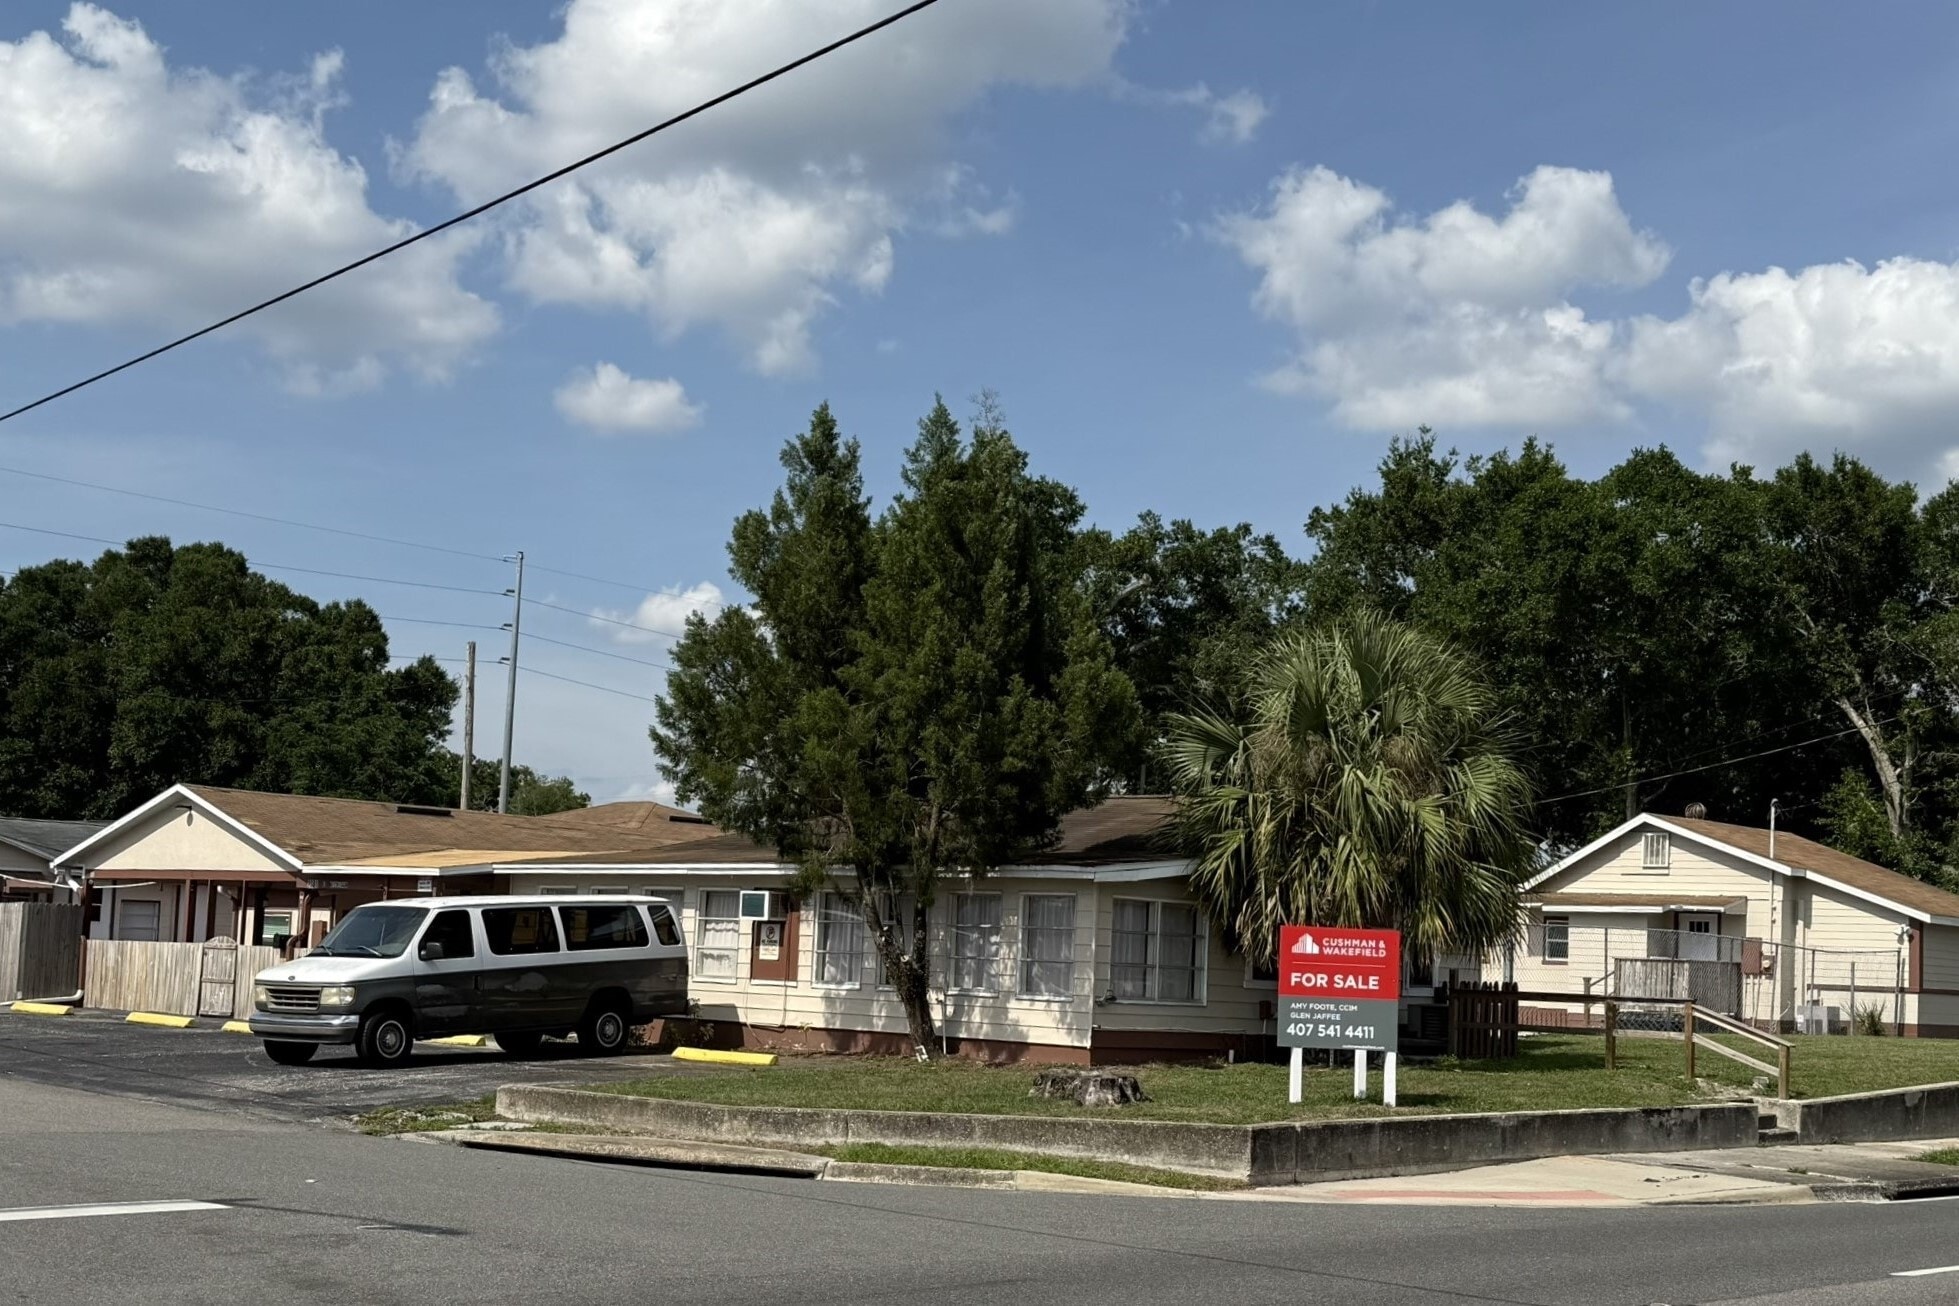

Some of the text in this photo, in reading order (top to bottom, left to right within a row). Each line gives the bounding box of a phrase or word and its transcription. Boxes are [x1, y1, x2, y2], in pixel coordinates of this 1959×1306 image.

[1322, 937, 1386, 948] CUSHMAN &
[1322, 947, 1386, 957] WAKEFIELD
[1290, 972, 1380, 990] FOR SALE
[1290, 1011, 1341, 1020] GLEN JAFFEE
[1286, 1023, 1375, 1039] 407 541 4411
